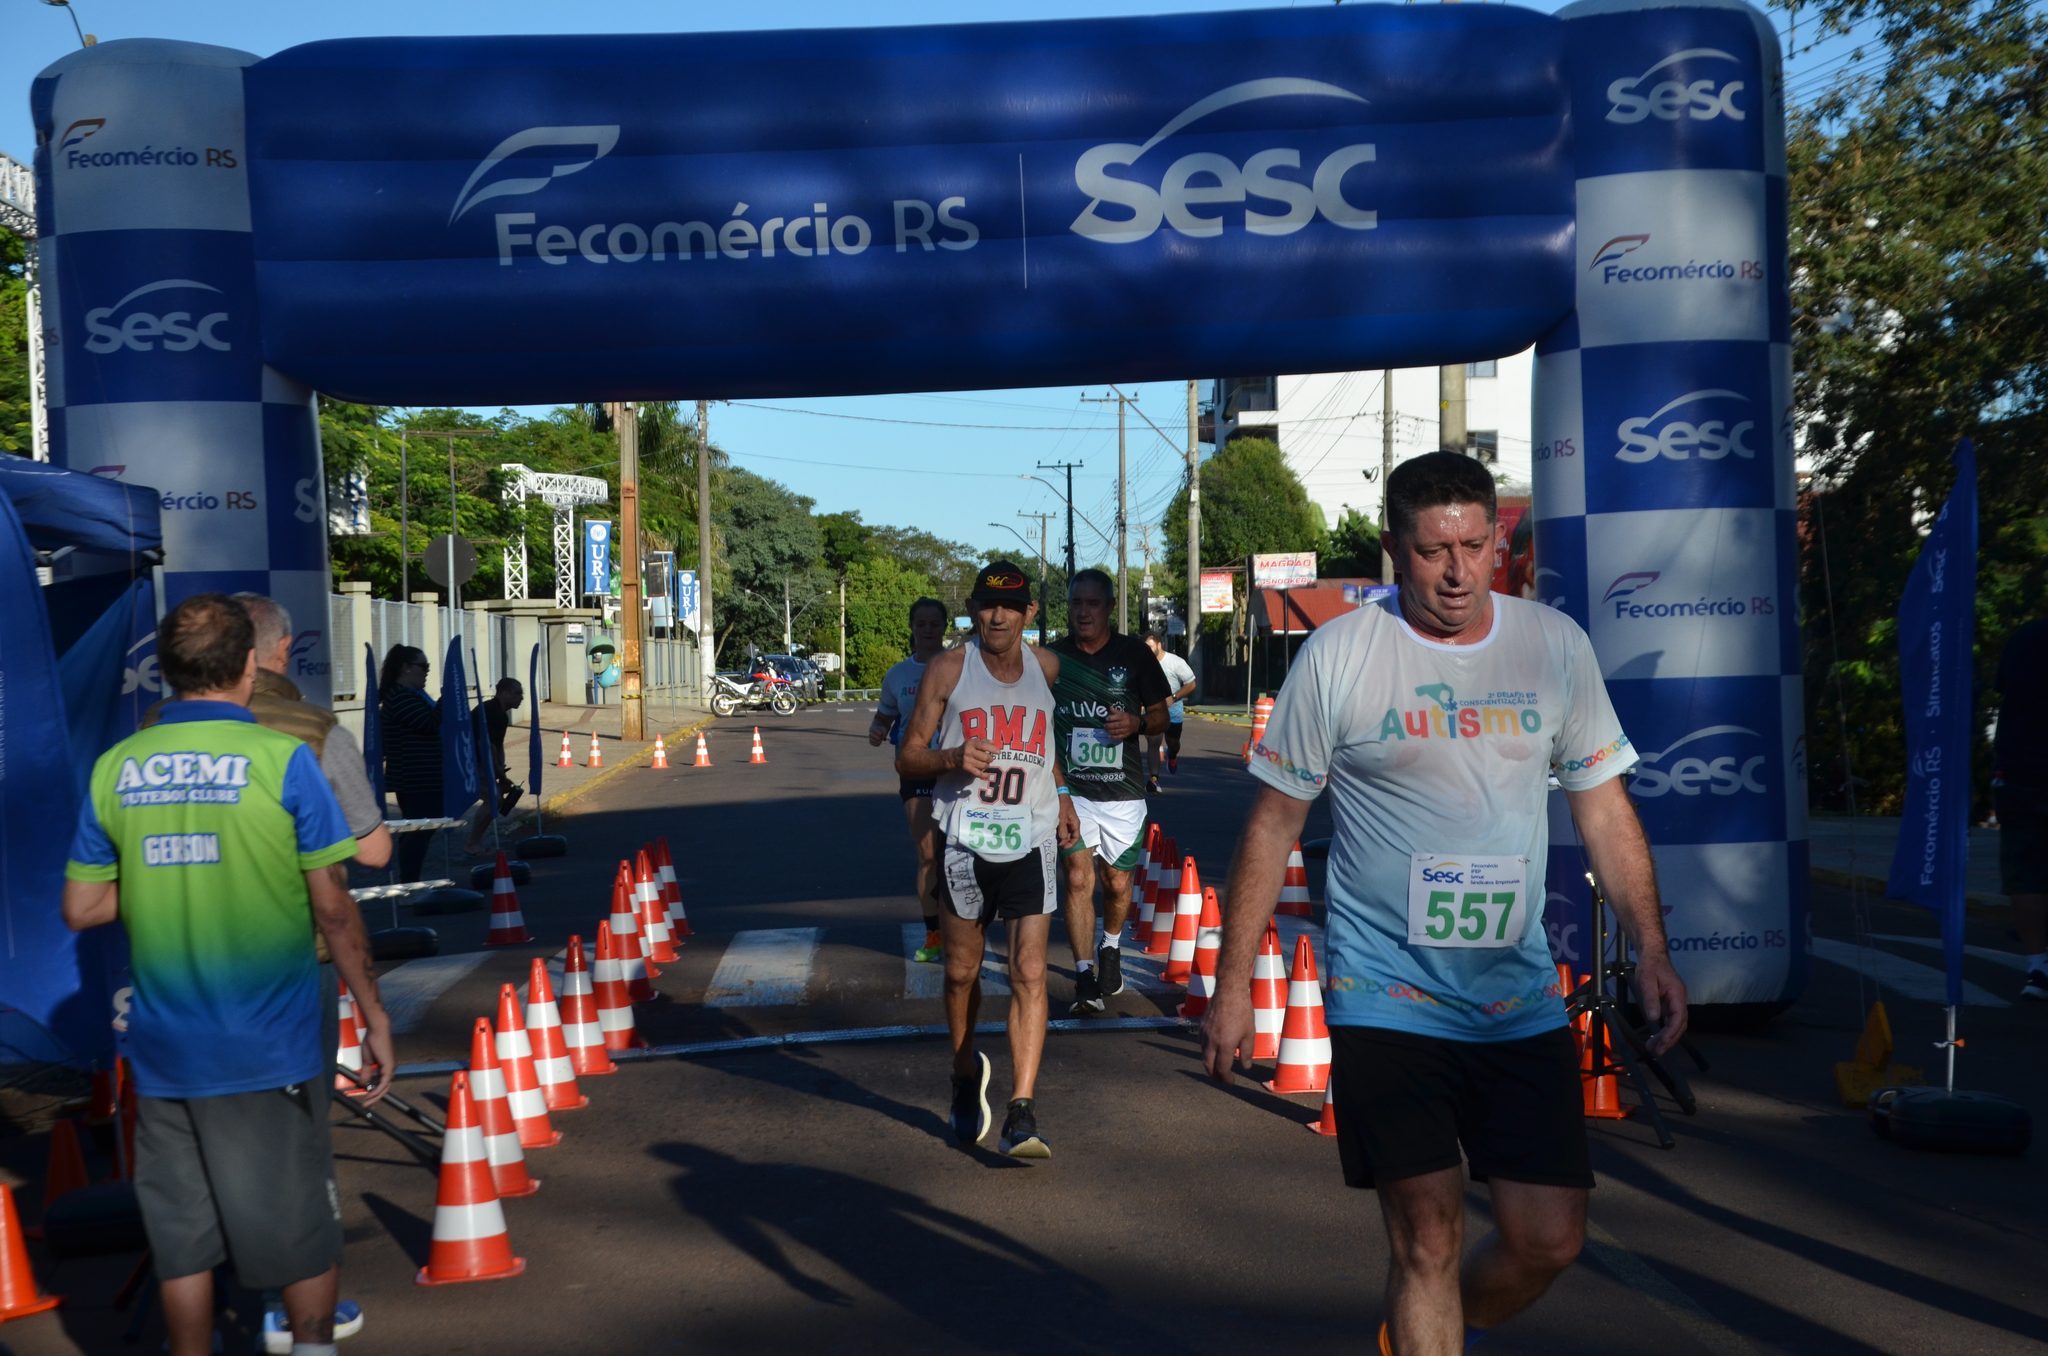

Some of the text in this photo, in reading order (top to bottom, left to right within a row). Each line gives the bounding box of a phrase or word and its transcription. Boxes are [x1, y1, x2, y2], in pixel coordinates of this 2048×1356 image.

[68, 146, 237, 169] Fecomércio RS
[495, 197, 980, 266] Fecomércio RS
[1604, 260, 1763, 284] Fecomércio RS
[1554, 439, 1576, 458] RS
[226, 491, 257, 510] RS
[591, 544, 605, 591] URI
[1616, 597, 1775, 619] Fecomércio RS
[1379, 704, 1542, 740] Autismo
[1078, 742, 1117, 765] 300
[116, 752, 252, 793] ACEMI
[979, 767, 1025, 806] 30
[188, 787, 240, 805] CLUBE
[1919, 746, 1942, 885] Fecomércio RS
[144, 833, 221, 866] GERSON
[969, 822, 1022, 850] 536
[1425, 890, 1516, 941] 557
[1669, 930, 1785, 952] omércio RS
